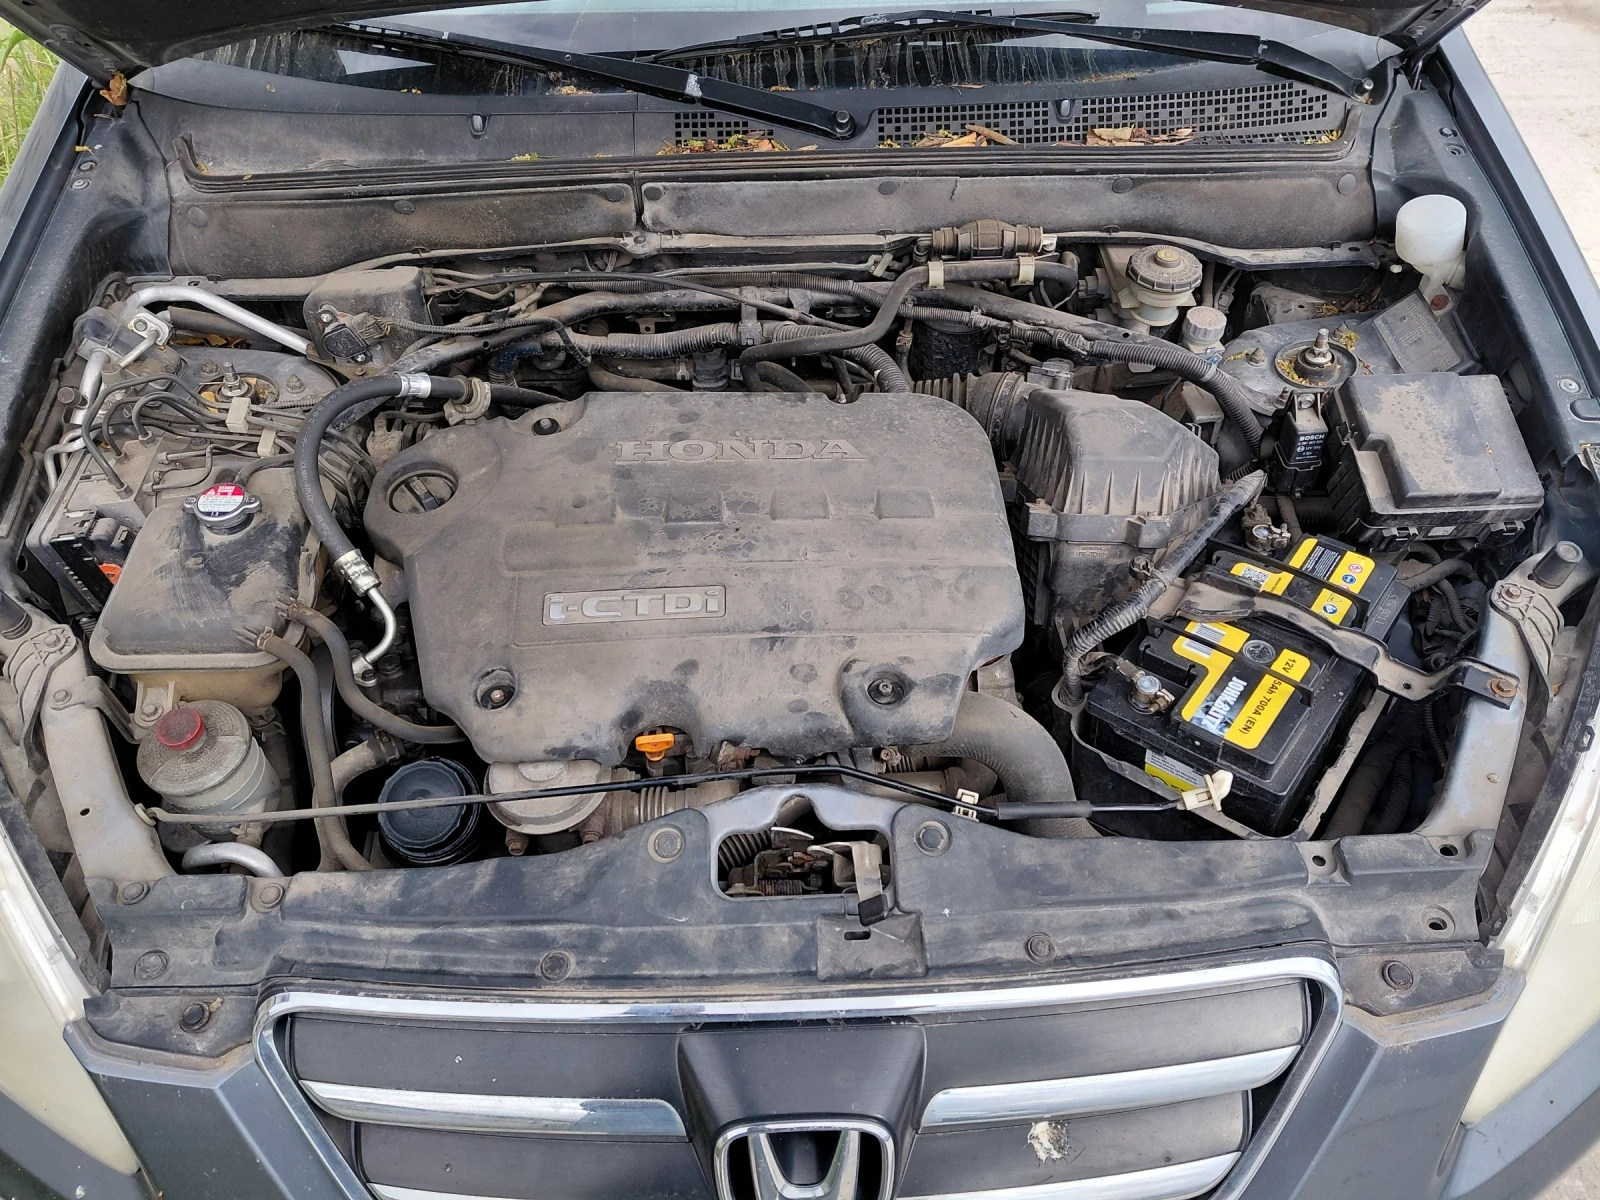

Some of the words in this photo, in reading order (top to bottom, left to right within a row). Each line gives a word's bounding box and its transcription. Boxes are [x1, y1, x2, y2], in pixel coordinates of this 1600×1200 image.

[615, 439, 868, 462] HONDA
[549, 588, 720, 621] i-CTDi
[1282, 657, 1297, 674] 12V
[1266, 679, 1283, 695] 5Ah
[1254, 695, 1272, 716] 700A
[1239, 715, 1257, 735] (EN)
